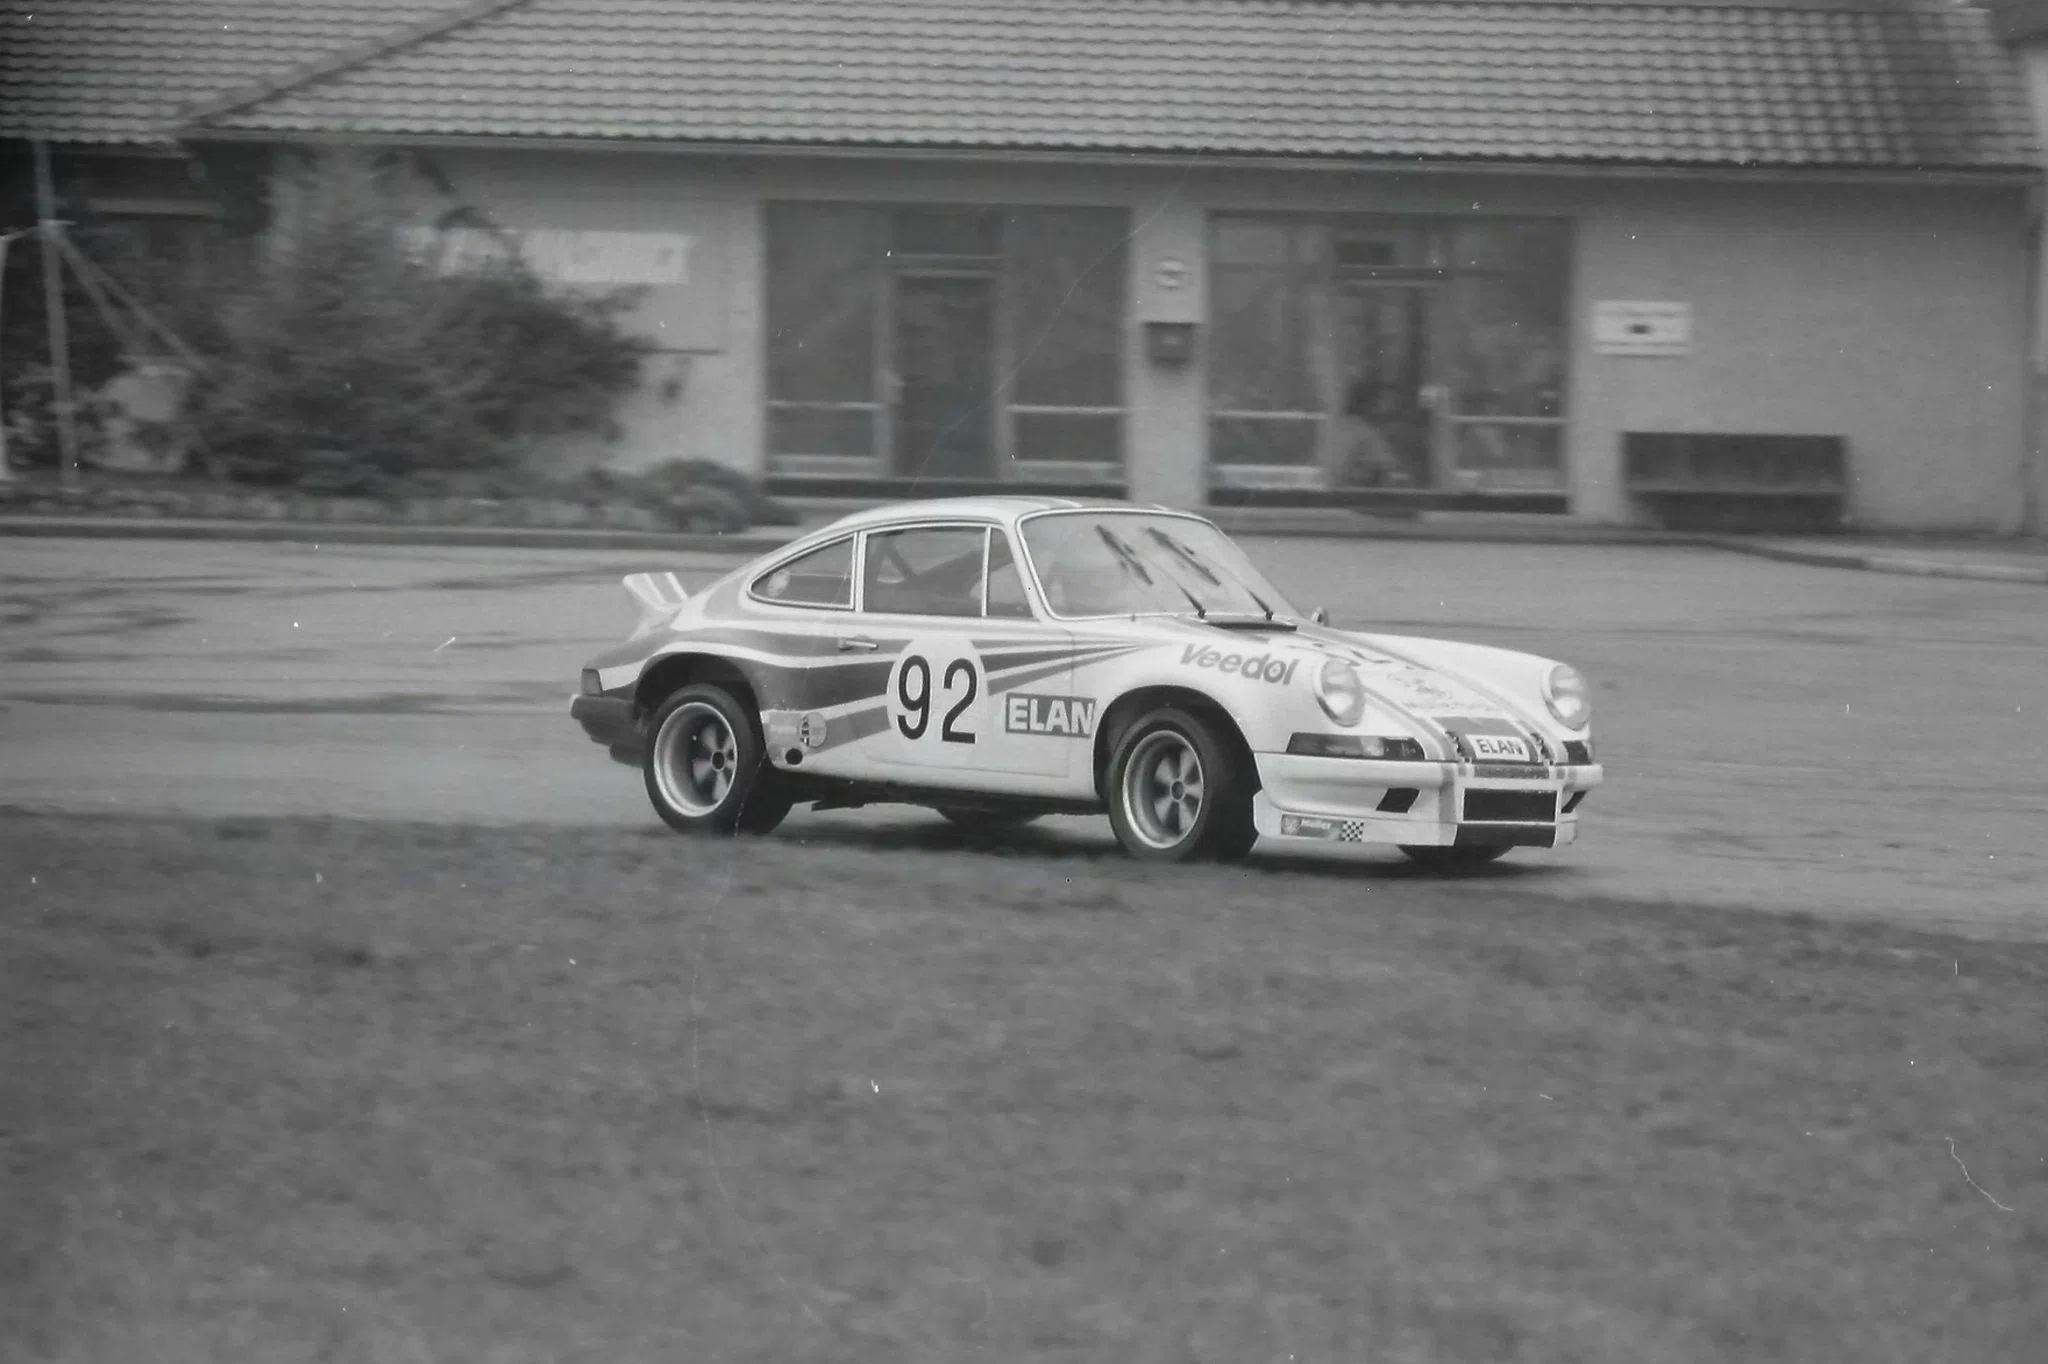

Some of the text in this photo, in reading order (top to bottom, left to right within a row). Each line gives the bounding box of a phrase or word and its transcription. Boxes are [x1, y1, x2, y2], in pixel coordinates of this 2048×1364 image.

[1180, 643, 1299, 685] Veedol
[897, 655, 978, 744] 92
[1007, 697, 1094, 735] ELAN
[1475, 739, 1524, 755] ELAN
